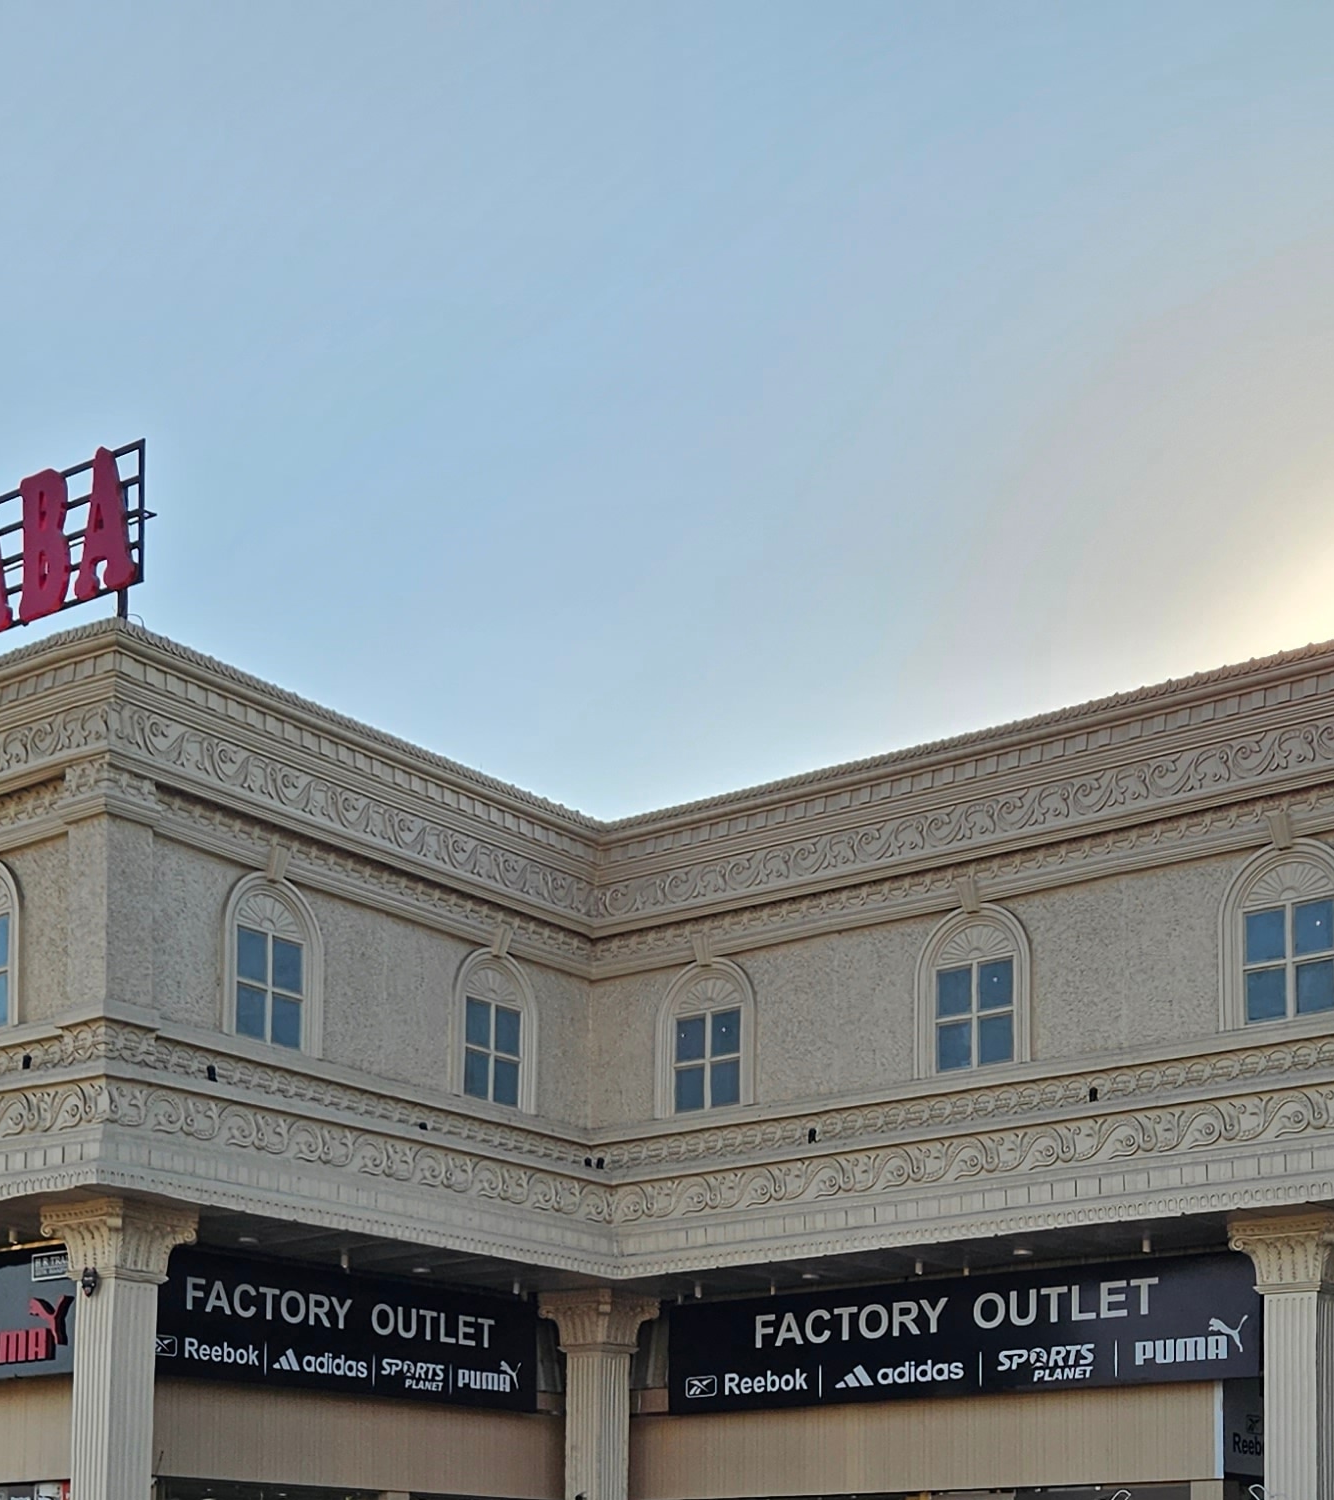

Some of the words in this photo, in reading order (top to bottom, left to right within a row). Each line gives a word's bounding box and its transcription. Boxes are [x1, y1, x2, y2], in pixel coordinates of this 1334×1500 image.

[186, 1277, 352, 1329] FACTORY
[371, 1304, 495, 1348] OUTLET
[755, 1297, 949, 1349] FACTORY
[973, 1277, 1159, 1330] OUTLET
[184, 1338, 259, 1365] Reebok
[997, 1343, 1095, 1372] SPORTS
[1135, 1333, 1228, 1366] PUMA
[302, 1352, 367, 1378] adidas
[381, 1358, 444, 1381] SPORTS
[877, 1359, 964, 1386] adidas
[1033, 1364, 1093, 1382] PLANET
[405, 1378, 443, 1392] PLANET
[458, 1368, 511, 1392] PUMA
[724, 1368, 807, 1396] Reebok
[1232, 1432, 1264, 1457] Reeb
